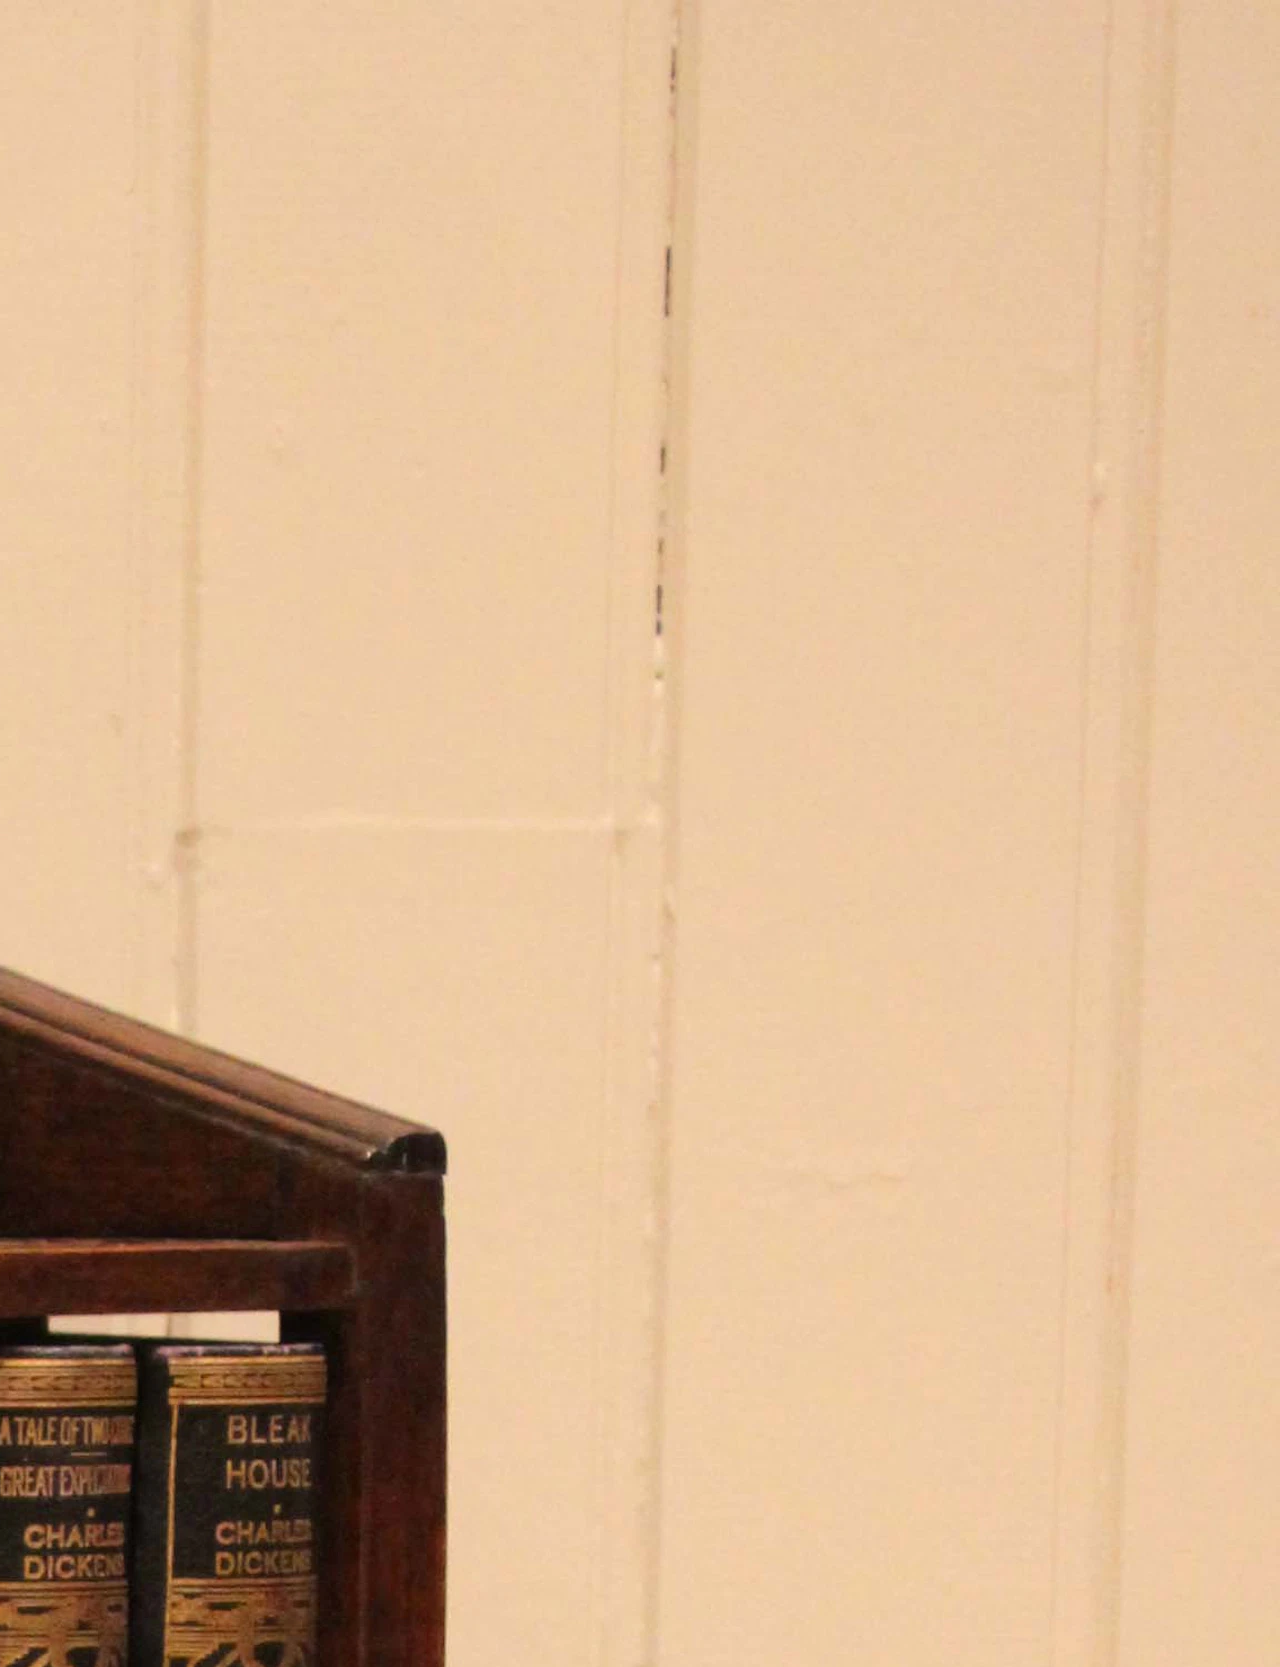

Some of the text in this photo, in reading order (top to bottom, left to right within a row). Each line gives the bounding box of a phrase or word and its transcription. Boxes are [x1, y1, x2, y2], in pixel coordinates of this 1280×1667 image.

[15, 1416, 57, 1446] TALE
[59, 1415, 82, 1446] OF
[227, 1414, 311, 1445] BLEAK
[0, 1465, 57, 1497] GREAT
[225, 1458, 311, 1490] HOUSE
[24, 1522, 125, 1549] CHARLES
[215, 1519, 312, 1546] CHARLES
[23, 1552, 125, 1580] DICKENS
[215, 1549, 311, 1576] DICKENS
